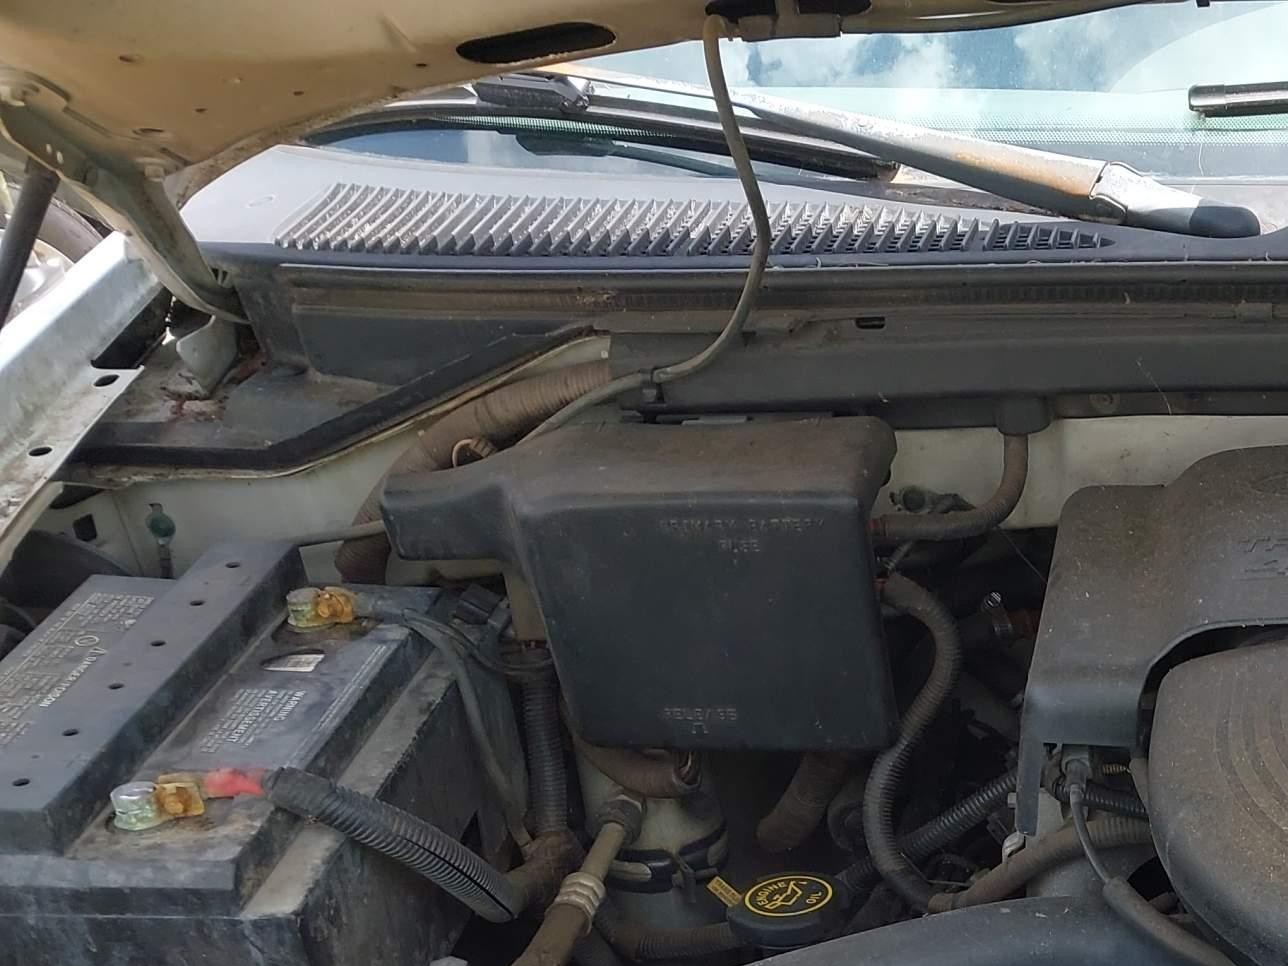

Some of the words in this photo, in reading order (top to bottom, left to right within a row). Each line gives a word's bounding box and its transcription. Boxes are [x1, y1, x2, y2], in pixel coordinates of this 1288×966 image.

[273, 690, 305, 722] WARNING
[756, 881, 786, 906] ENGINE
[806, 891, 822, 904] OIL
